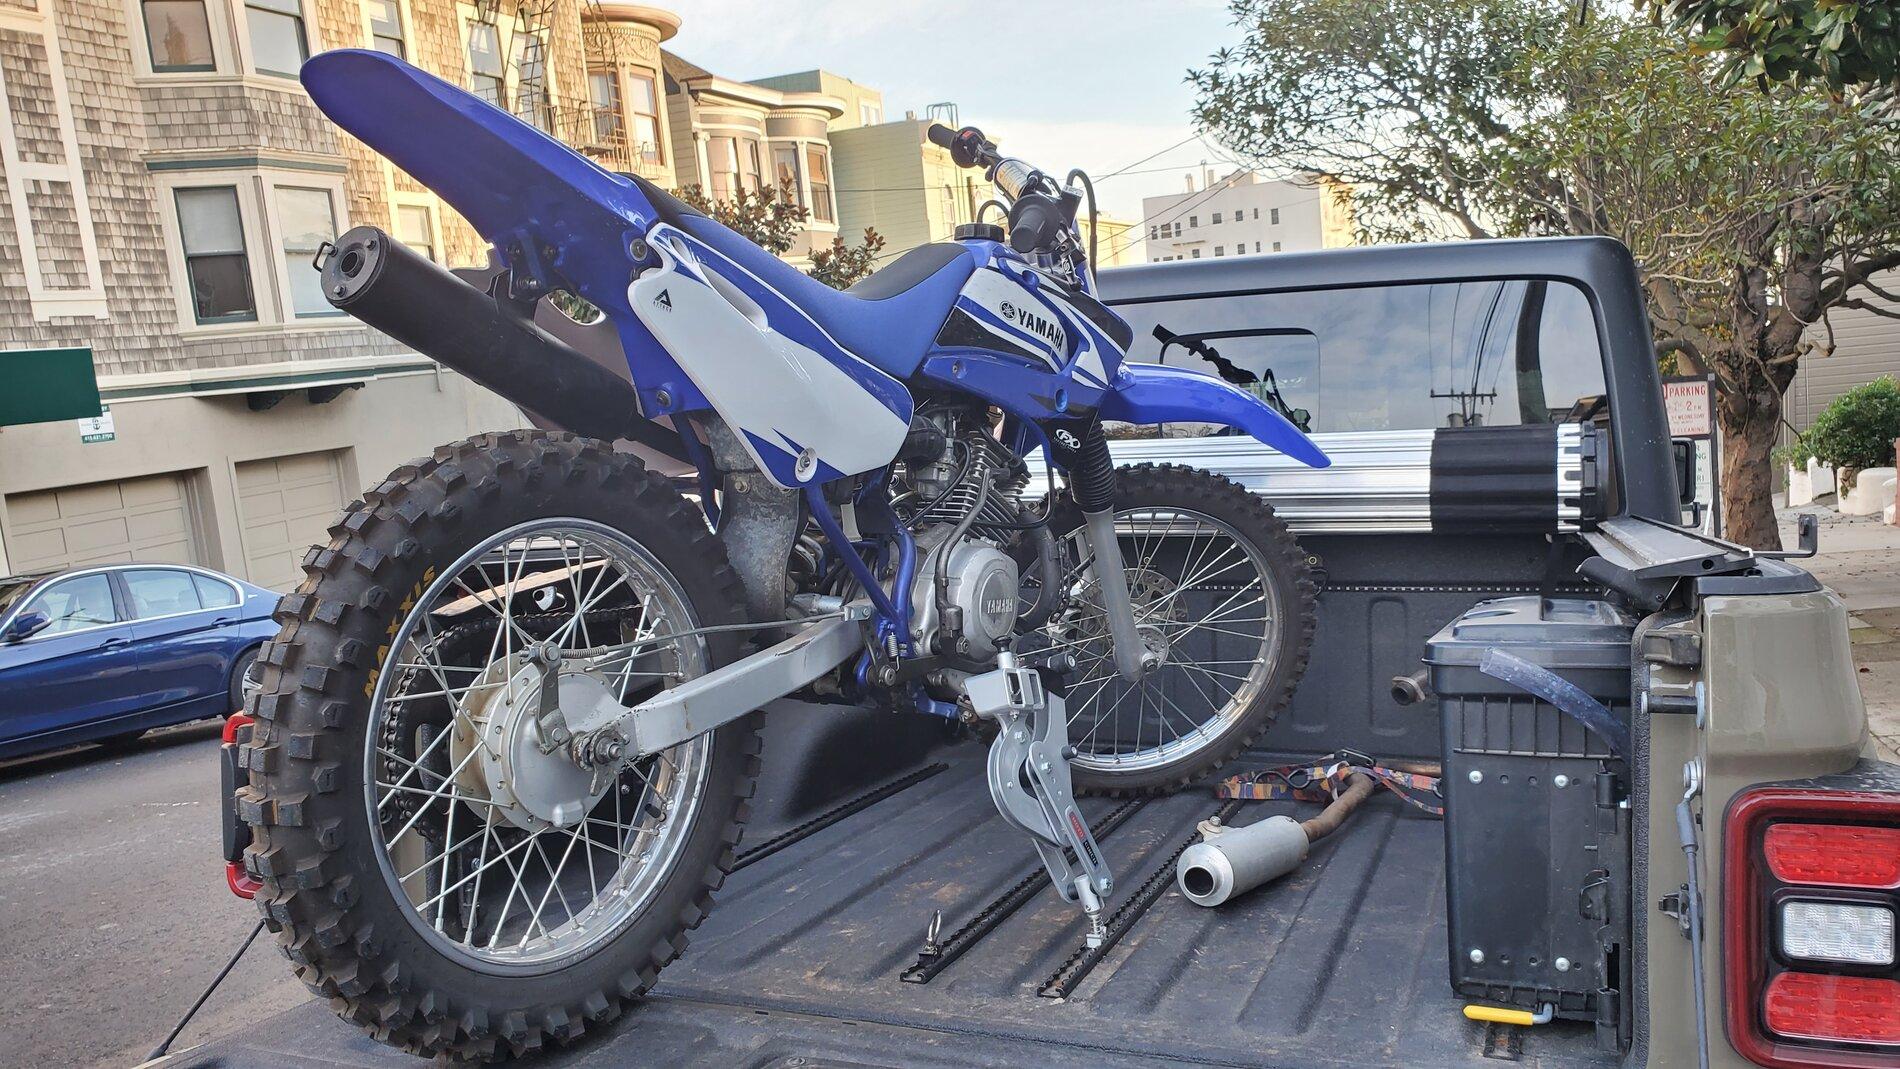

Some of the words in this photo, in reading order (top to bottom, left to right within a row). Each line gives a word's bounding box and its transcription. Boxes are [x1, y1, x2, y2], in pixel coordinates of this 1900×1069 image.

[1017, 307, 1064, 353] YAMAHA
[1669, 384, 1706, 397] PARKING
[986, 598, 1013, 614] YAMAHA
[364, 565, 436, 700] MAXXIS
